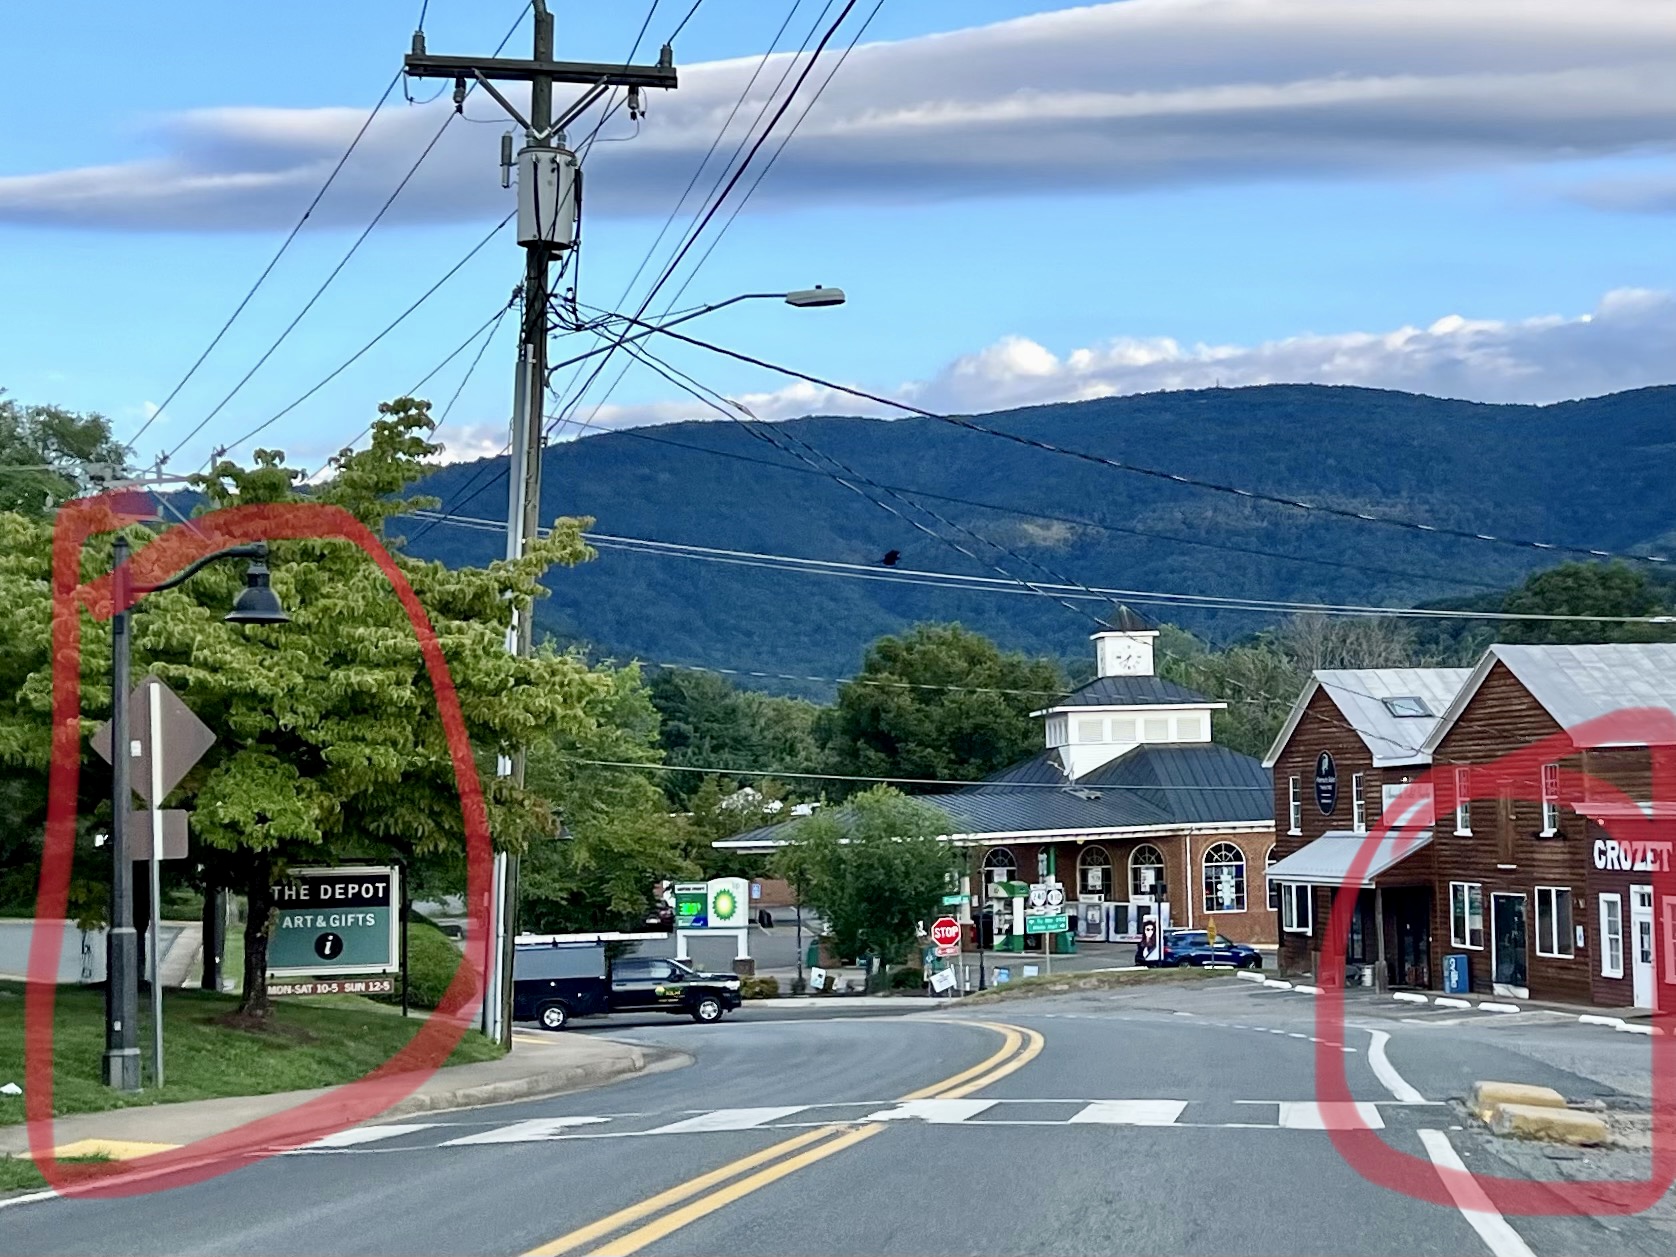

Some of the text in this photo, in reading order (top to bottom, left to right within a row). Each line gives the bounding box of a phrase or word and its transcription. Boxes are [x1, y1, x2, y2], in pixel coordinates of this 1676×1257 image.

[1594, 839, 1673, 872] CROZET
[271, 883, 387, 900] THE DEPOT
[282, 913, 375, 928] ART & GIFTS
[934, 926, 959, 939] STOP
[267, 981, 390, 994] MON-SAT 10-5 SUN 12-5
